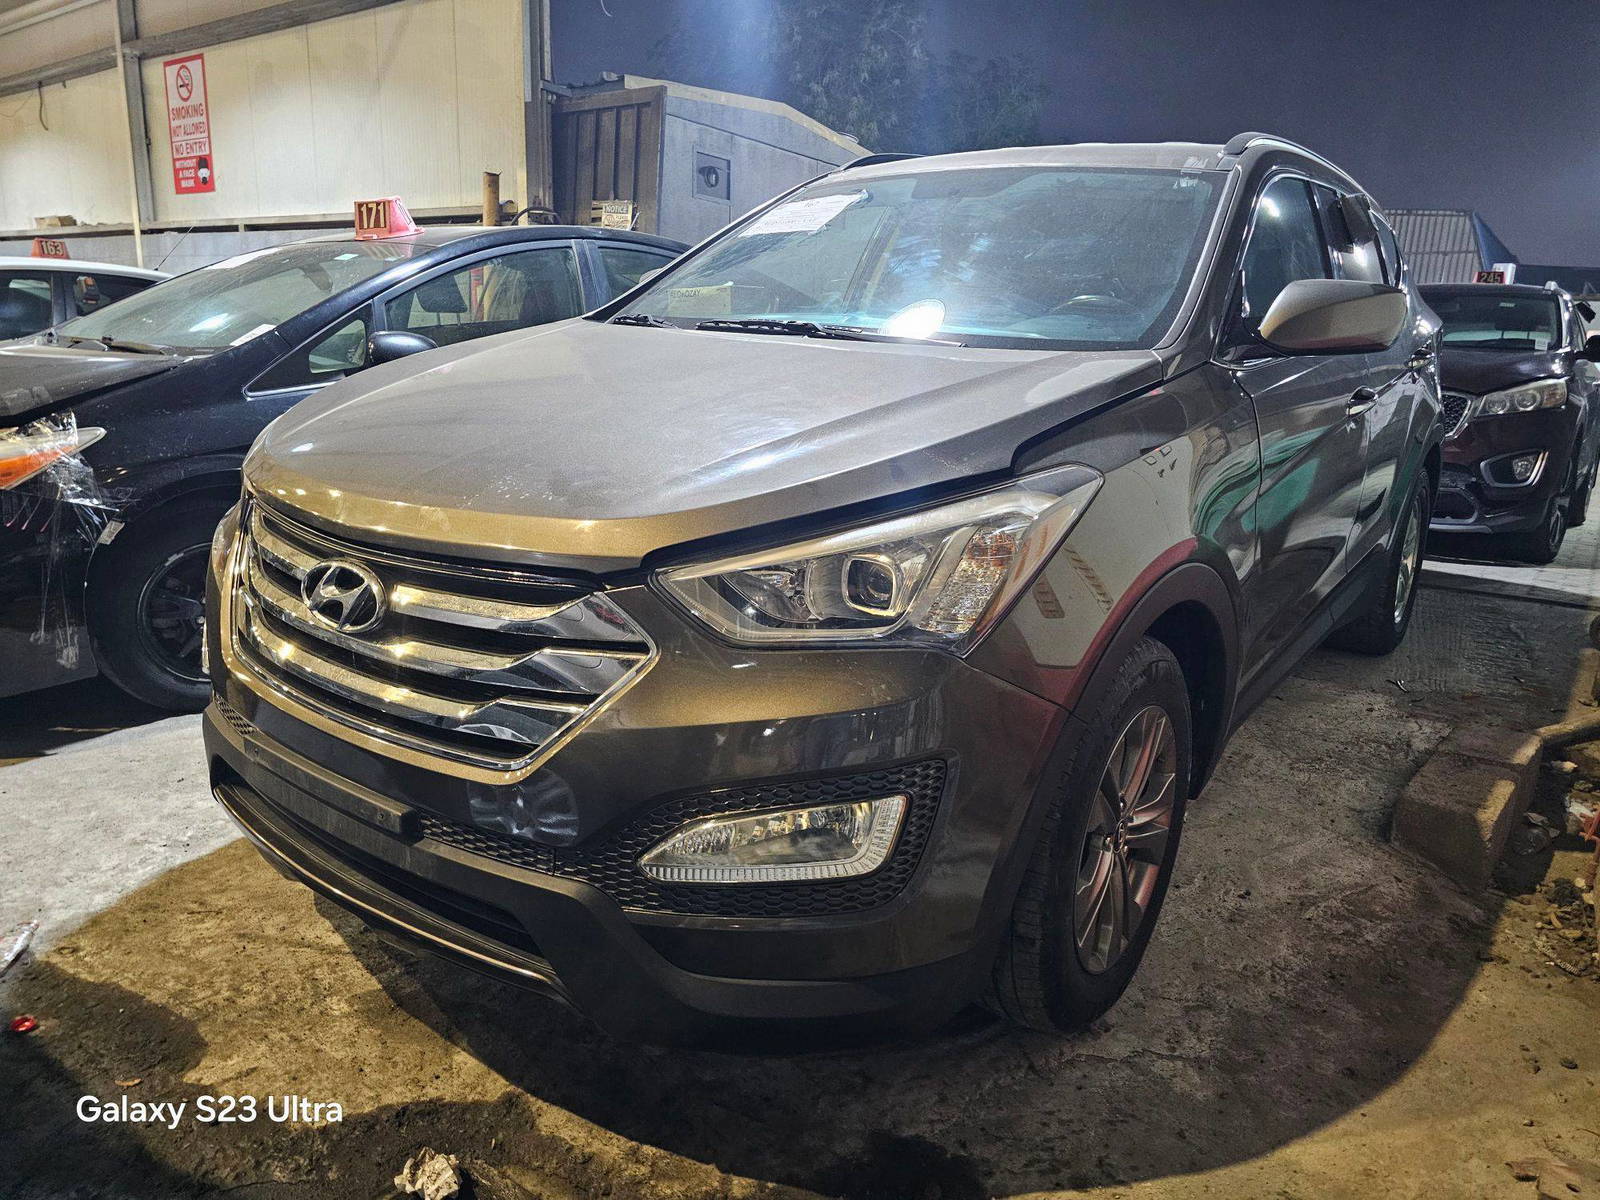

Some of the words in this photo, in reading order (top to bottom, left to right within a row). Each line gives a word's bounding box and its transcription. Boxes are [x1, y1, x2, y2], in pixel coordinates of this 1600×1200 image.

[171, 103, 204, 121] SMOKING
[184, 121, 206, 136] ALLOWED
[175, 143, 184, 155] NO
[185, 140, 207, 154] ENTRY
[361, 202, 384, 229] 171
[605, 204, 628, 213] NOTICE
[41, 240, 64, 255] 163
[1481, 272, 1502, 282] 245
